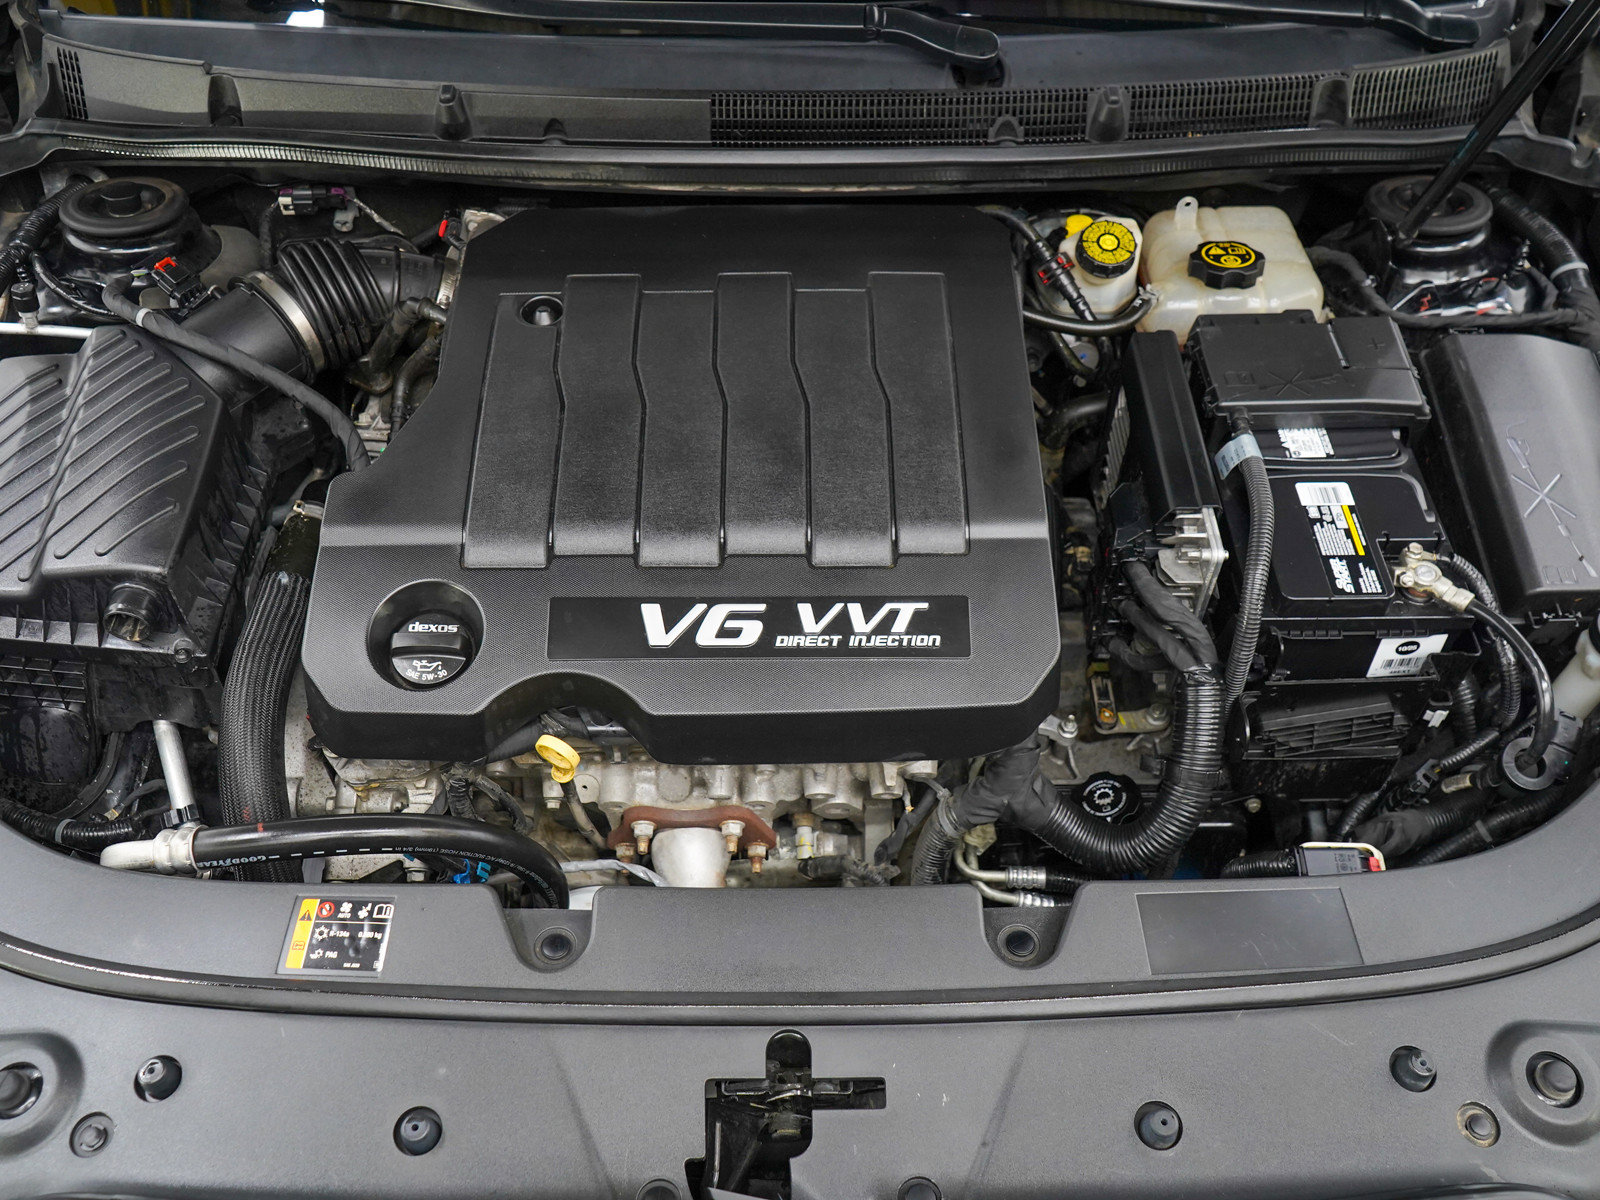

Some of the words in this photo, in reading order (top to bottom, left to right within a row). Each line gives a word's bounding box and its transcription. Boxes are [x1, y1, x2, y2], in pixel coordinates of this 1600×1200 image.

[408, 622, 459, 633] dexos
[640, 603, 767, 648] V6
[797, 602, 929, 635] VVT
[775, 635, 842, 648] DIRECT
[848, 635, 941, 648] INJECTION
[405, 669, 420, 680] SAE
[421, 669, 448, 681] 5W-30
[439, 848, 459, 856] HOSE
[459, 850, 486, 860] SUCTION
[197, 855, 267, 867] GOODYEAR
[329, 930, 350, 938] R-134a
[325, 951, 338, 959] PAG
